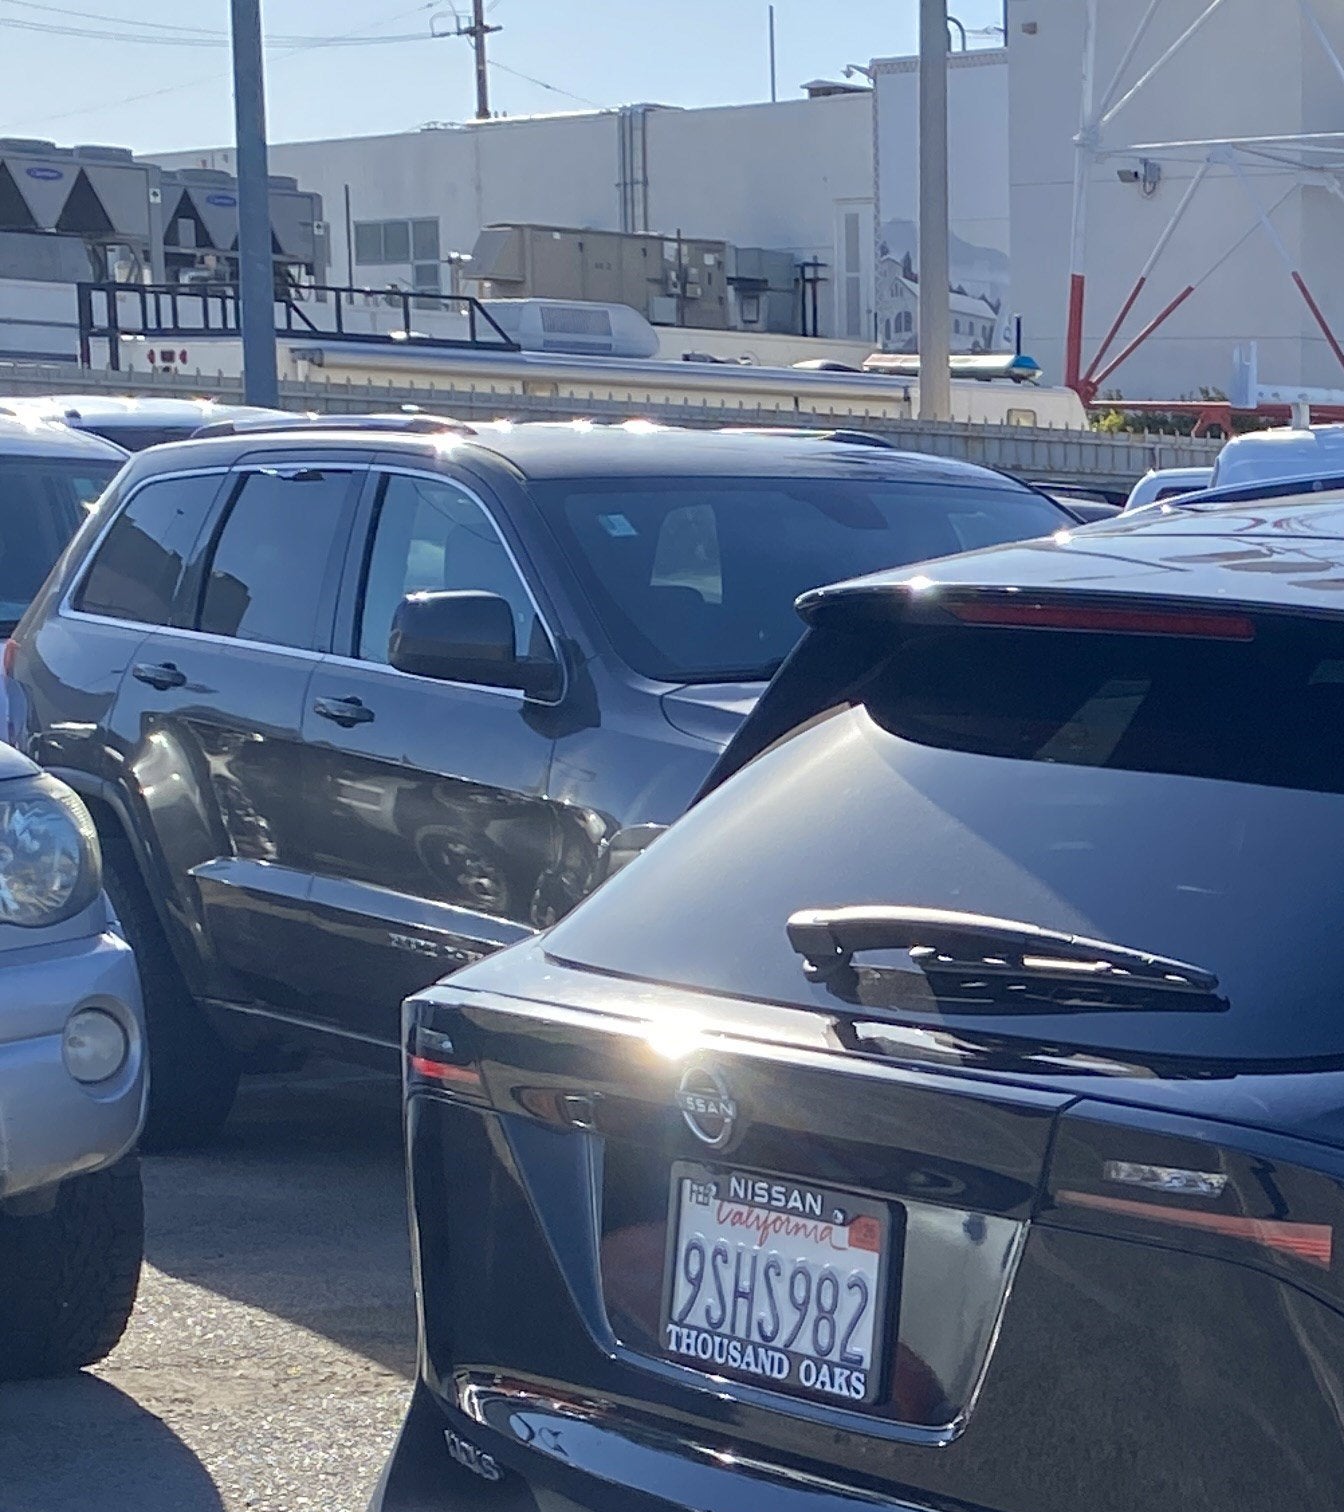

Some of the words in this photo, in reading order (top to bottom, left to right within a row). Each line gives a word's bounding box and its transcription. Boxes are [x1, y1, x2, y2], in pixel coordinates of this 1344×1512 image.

[716, 1201, 848, 1250] California
[730, 1176, 823, 1216] NISSAN
[678, 1238, 869, 1366] 9SHS982
[666, 1323, 790, 1380] THOUSAND
[799, 1358, 866, 1401] OAKS
